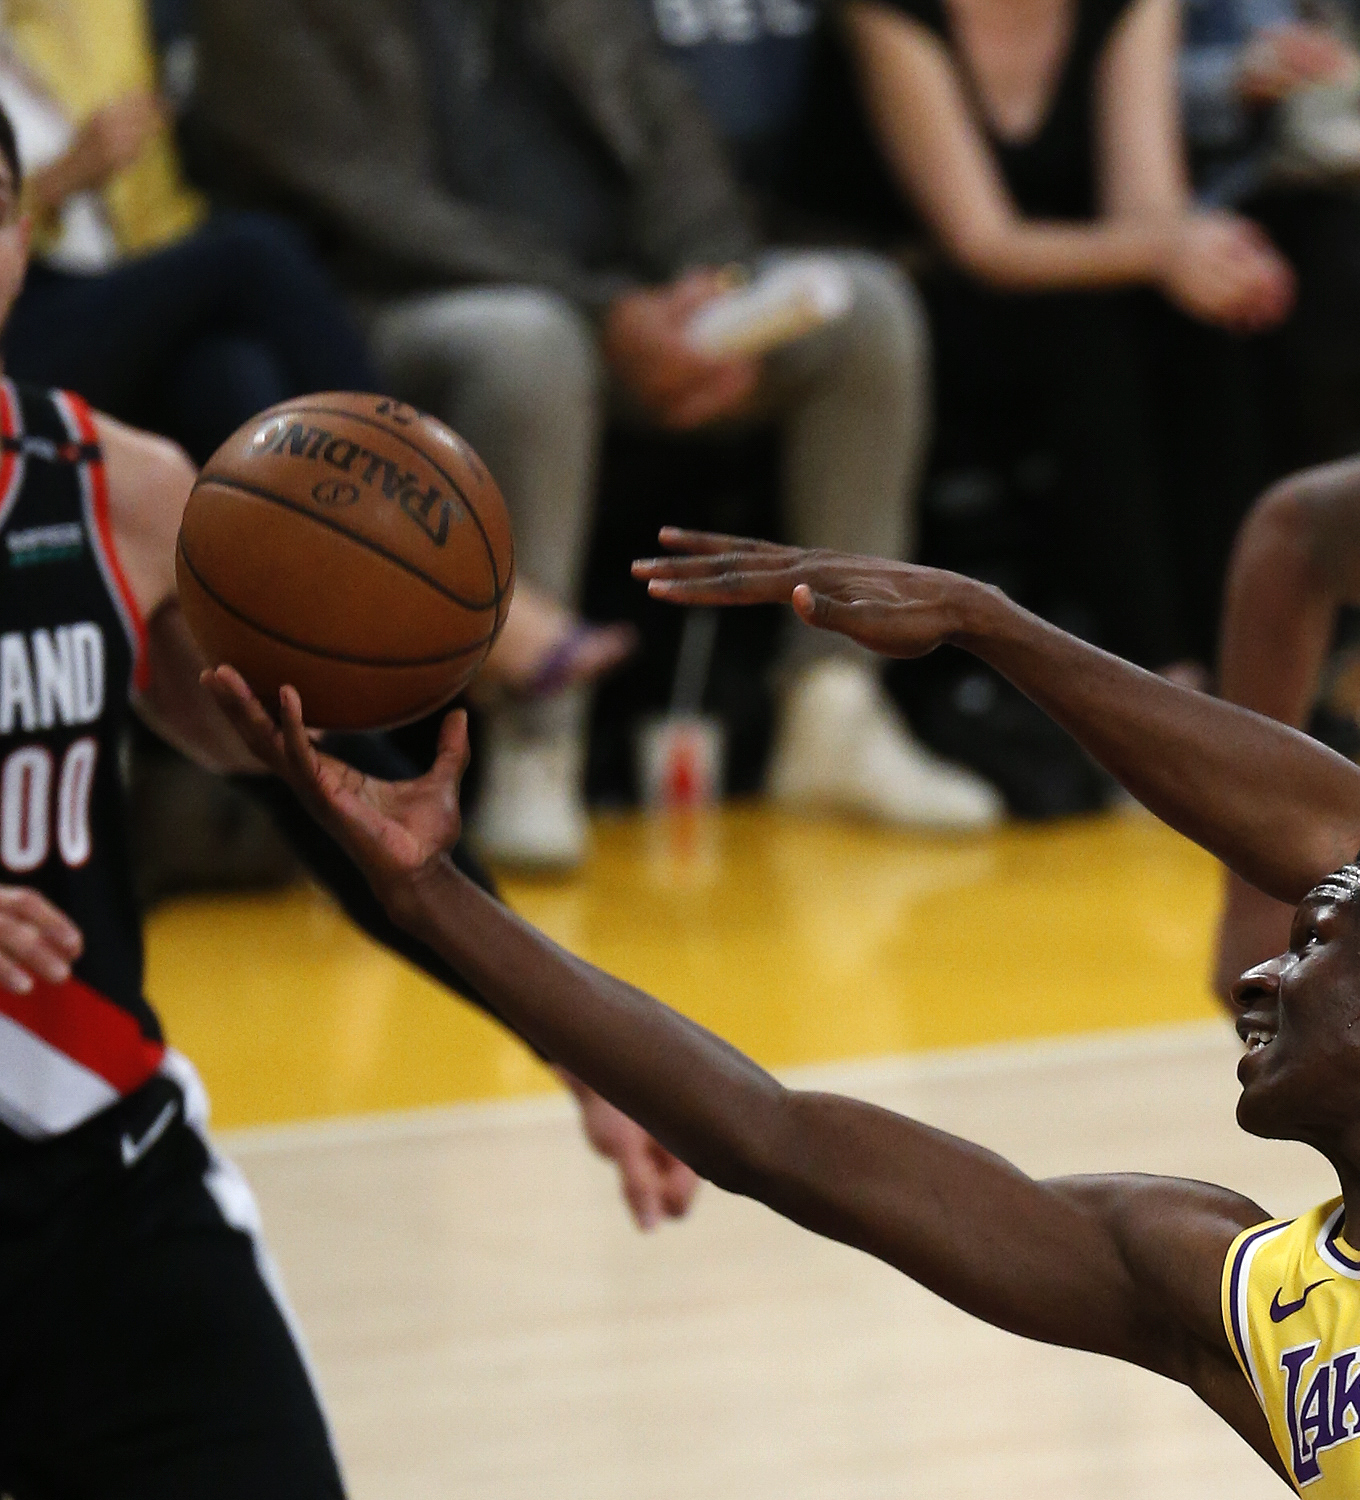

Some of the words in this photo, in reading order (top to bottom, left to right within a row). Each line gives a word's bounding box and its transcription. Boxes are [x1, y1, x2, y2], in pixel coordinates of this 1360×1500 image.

[244, 416, 465, 548] SPALDING
[0, 620, 105, 735] AND
[0, 736, 99, 873] 00
